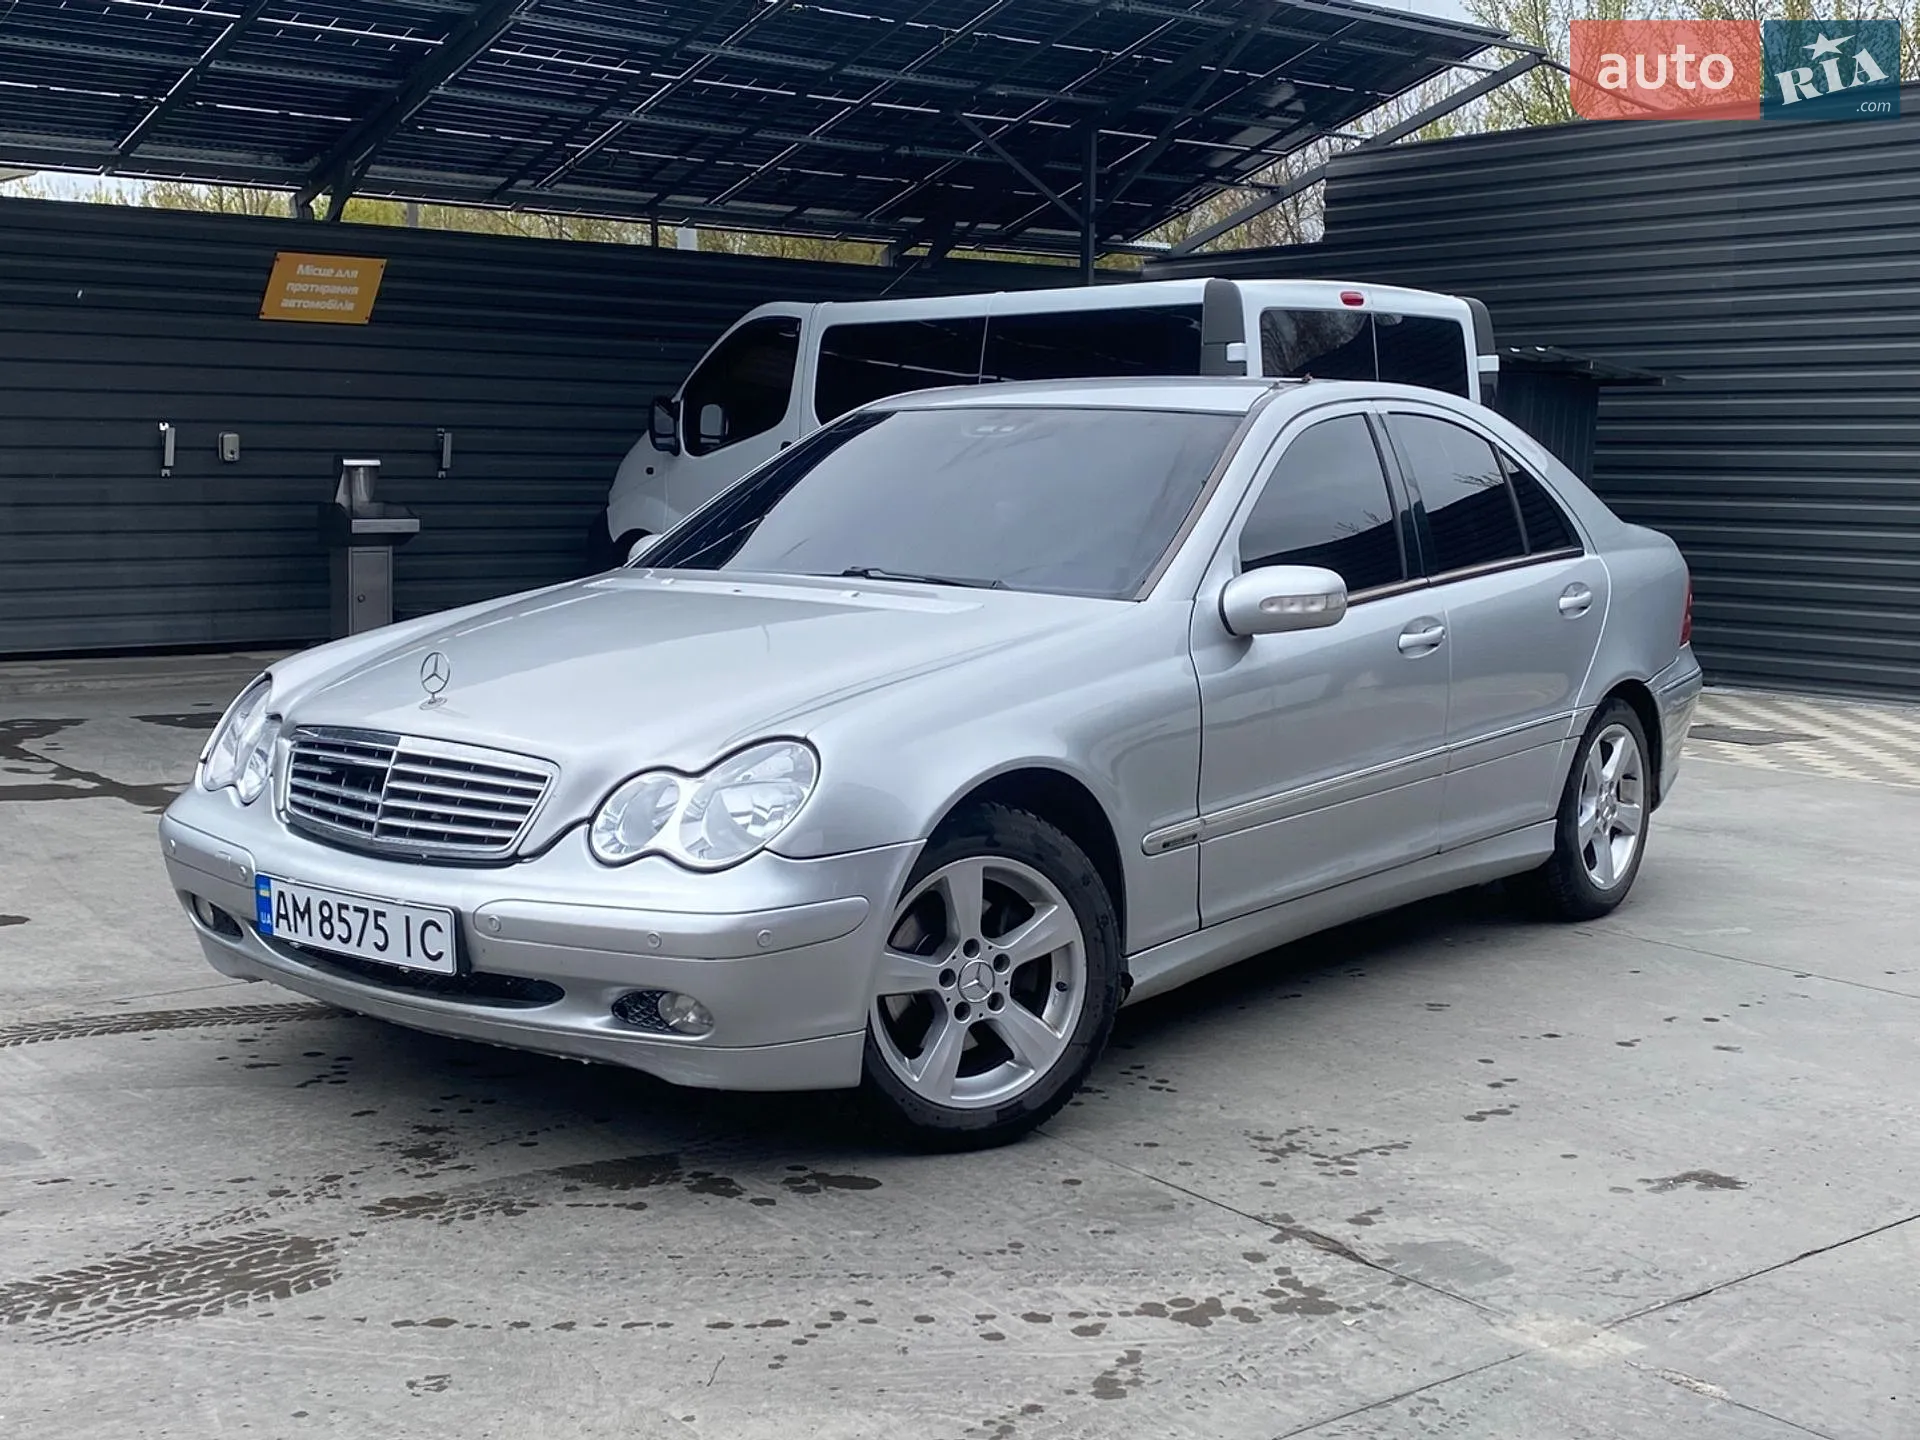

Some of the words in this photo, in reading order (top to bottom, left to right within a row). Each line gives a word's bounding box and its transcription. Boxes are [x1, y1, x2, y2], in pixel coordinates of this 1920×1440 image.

[297, 264, 334, 277] Місце
[335, 269, 359, 279] для
[286, 282, 359, 295] протирання
[280, 298, 355, 311] автомобілів
[260, 911, 272, 926] UA
[404, 914, 446, 962] IC
